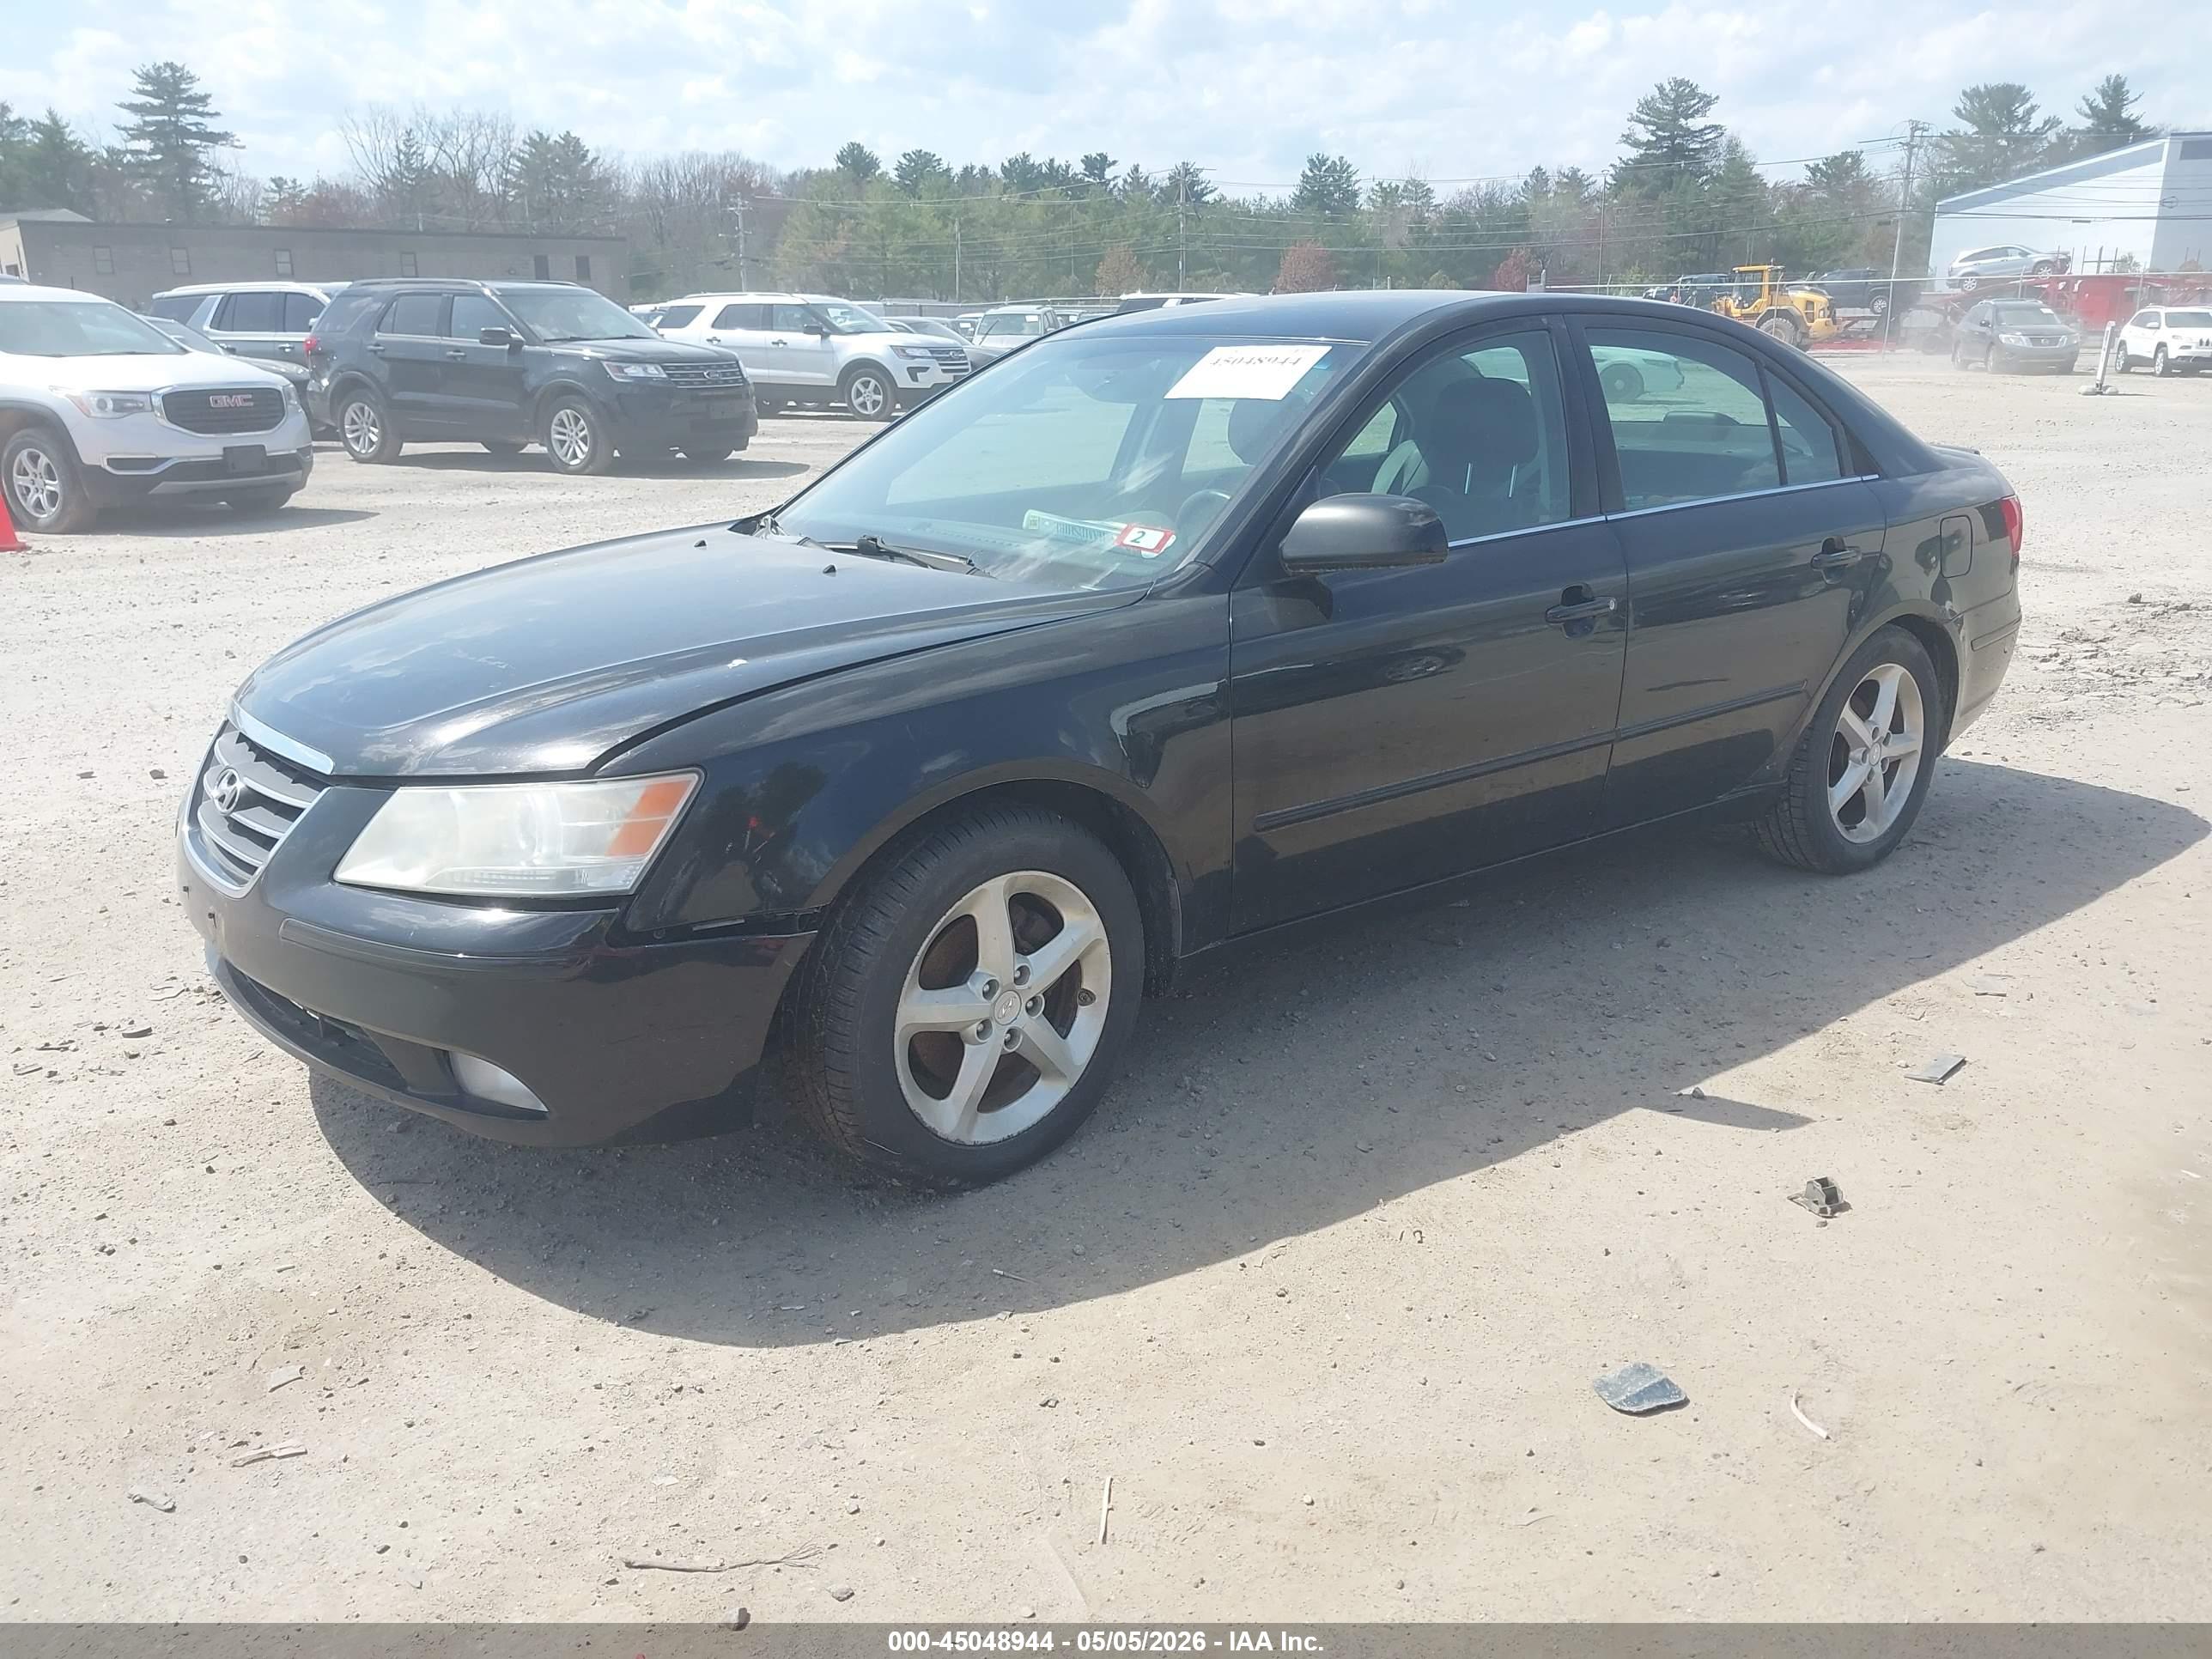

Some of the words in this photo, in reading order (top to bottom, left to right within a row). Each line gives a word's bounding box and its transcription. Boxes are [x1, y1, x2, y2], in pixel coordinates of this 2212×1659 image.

[1209, 356, 1303, 366] 45048944
[210, 394, 254, 408] GMC
[1130, 531, 1146, 544] 2
